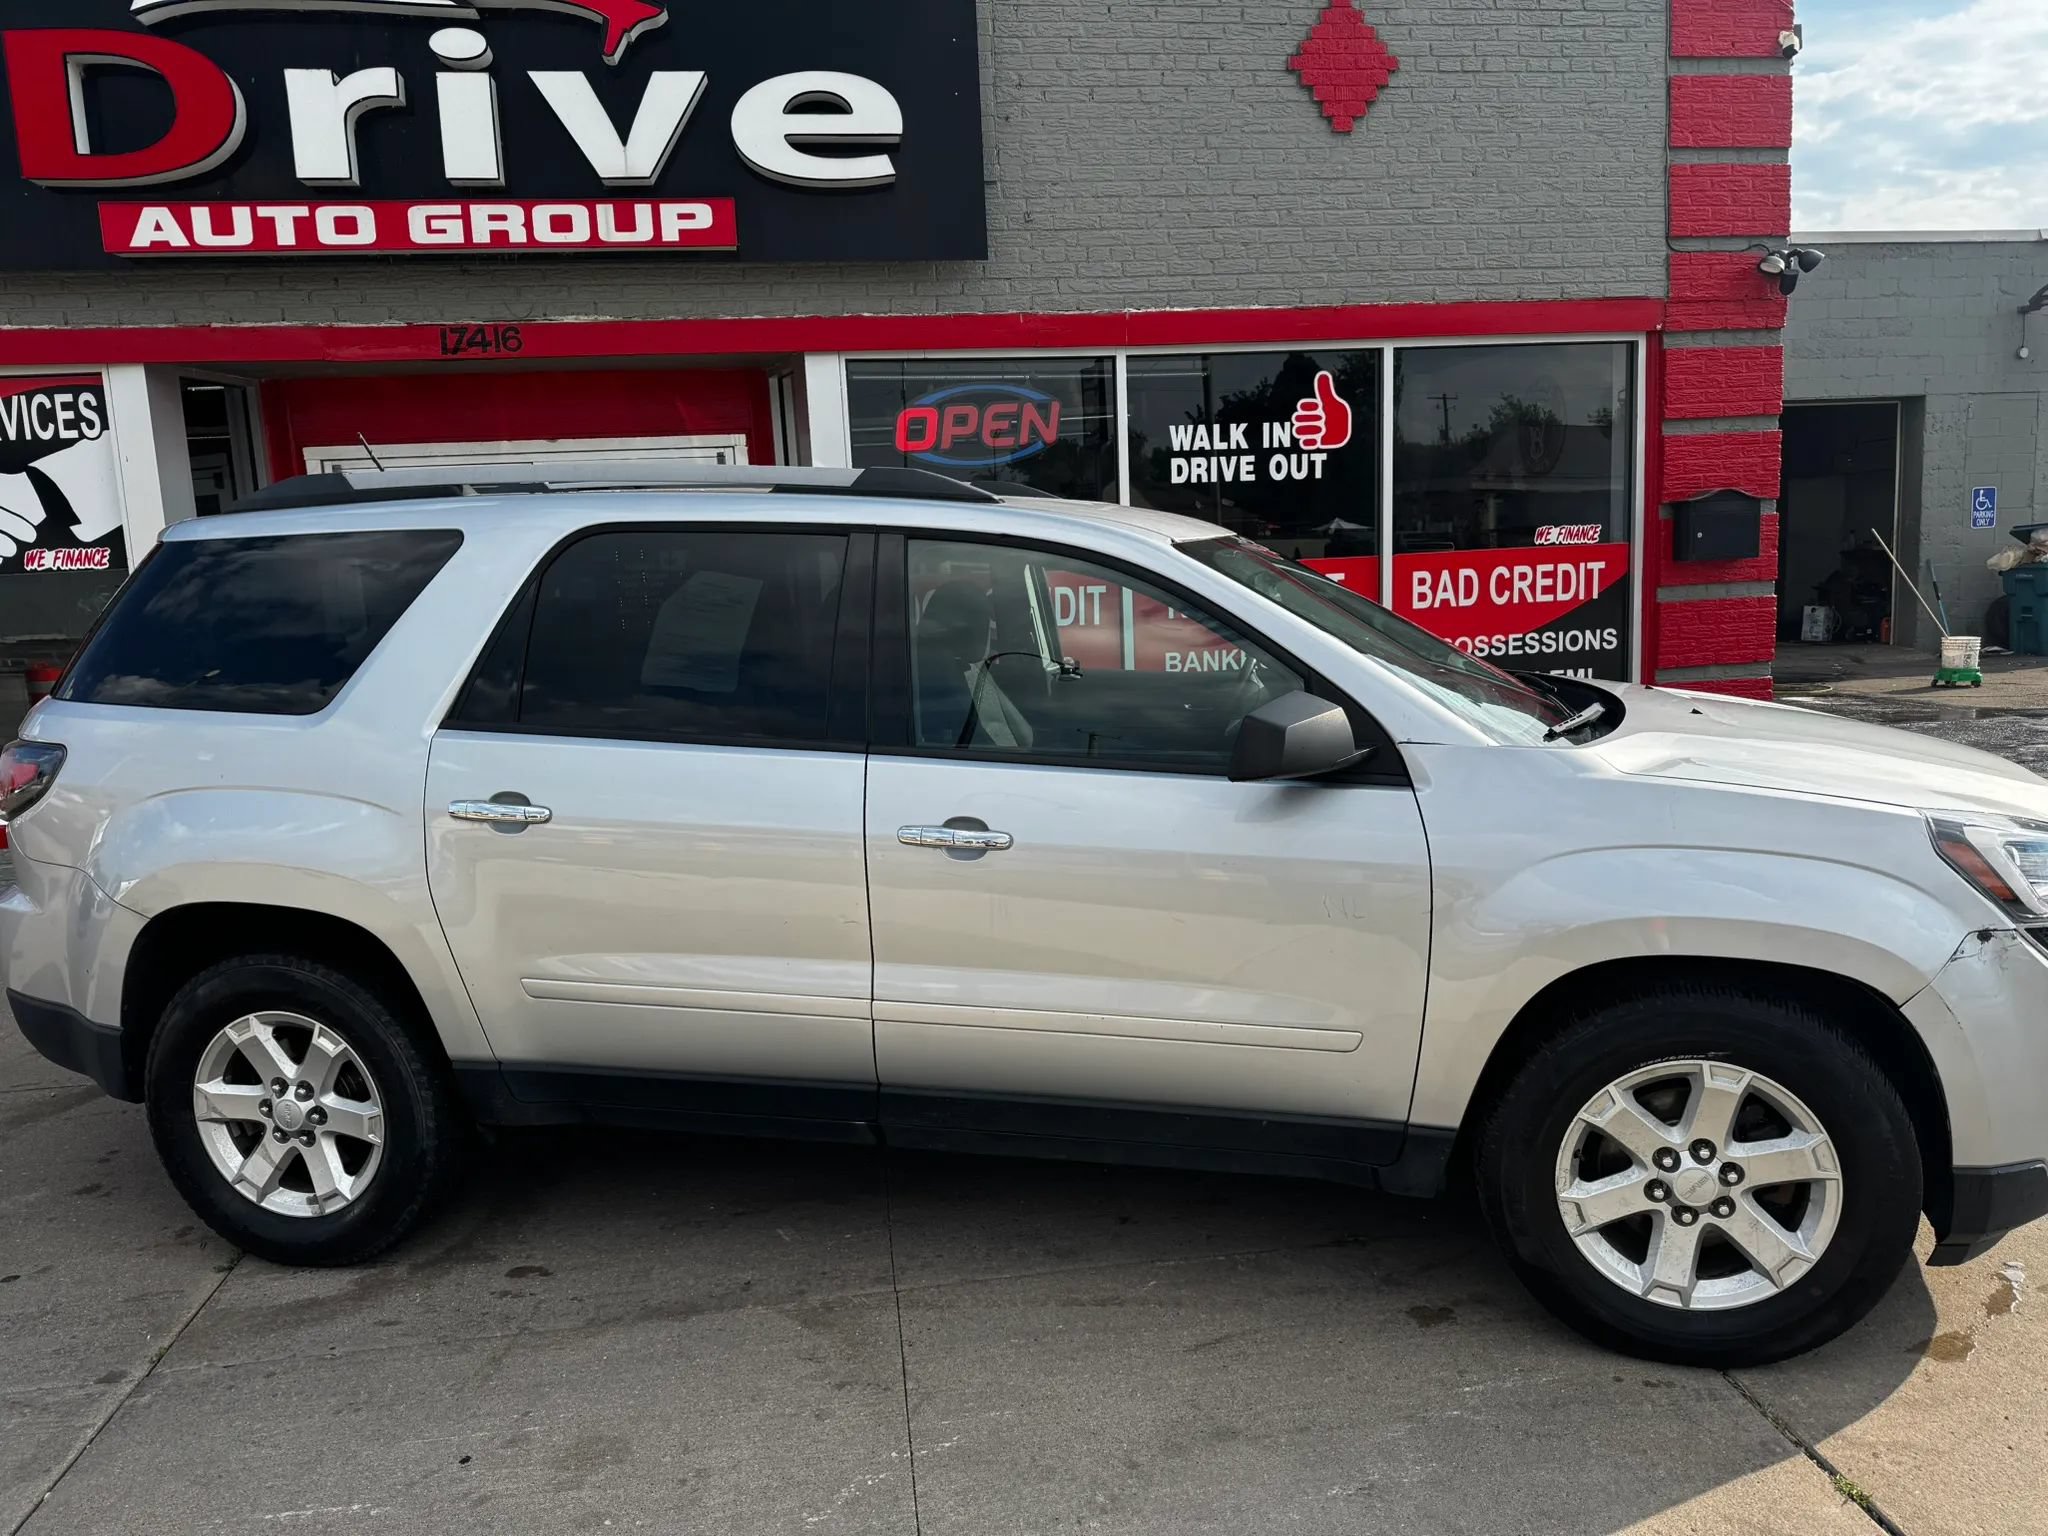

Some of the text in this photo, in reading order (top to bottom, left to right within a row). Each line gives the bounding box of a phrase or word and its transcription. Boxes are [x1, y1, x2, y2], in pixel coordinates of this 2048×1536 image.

[3, 27, 904, 188] Drive
[129, 202, 714, 248] AUTO GROUP
[440, 324, 523, 355] 17416
[0, 391, 102, 441] VICES
[895, 400, 1061, 452] OPEN
[1169, 421, 1291, 451] WALK IN
[1171, 453, 1328, 484] DRIVE OUT
[1535, 524, 1602, 544] WE FINANCE
[24, 548, 110, 570] WE FINANCE
[1412, 561, 1606, 610] BAD CREDIT
[1049, 585, 1107, 627] DIT
[1444, 628, 1618, 658] OSSESSIONS
